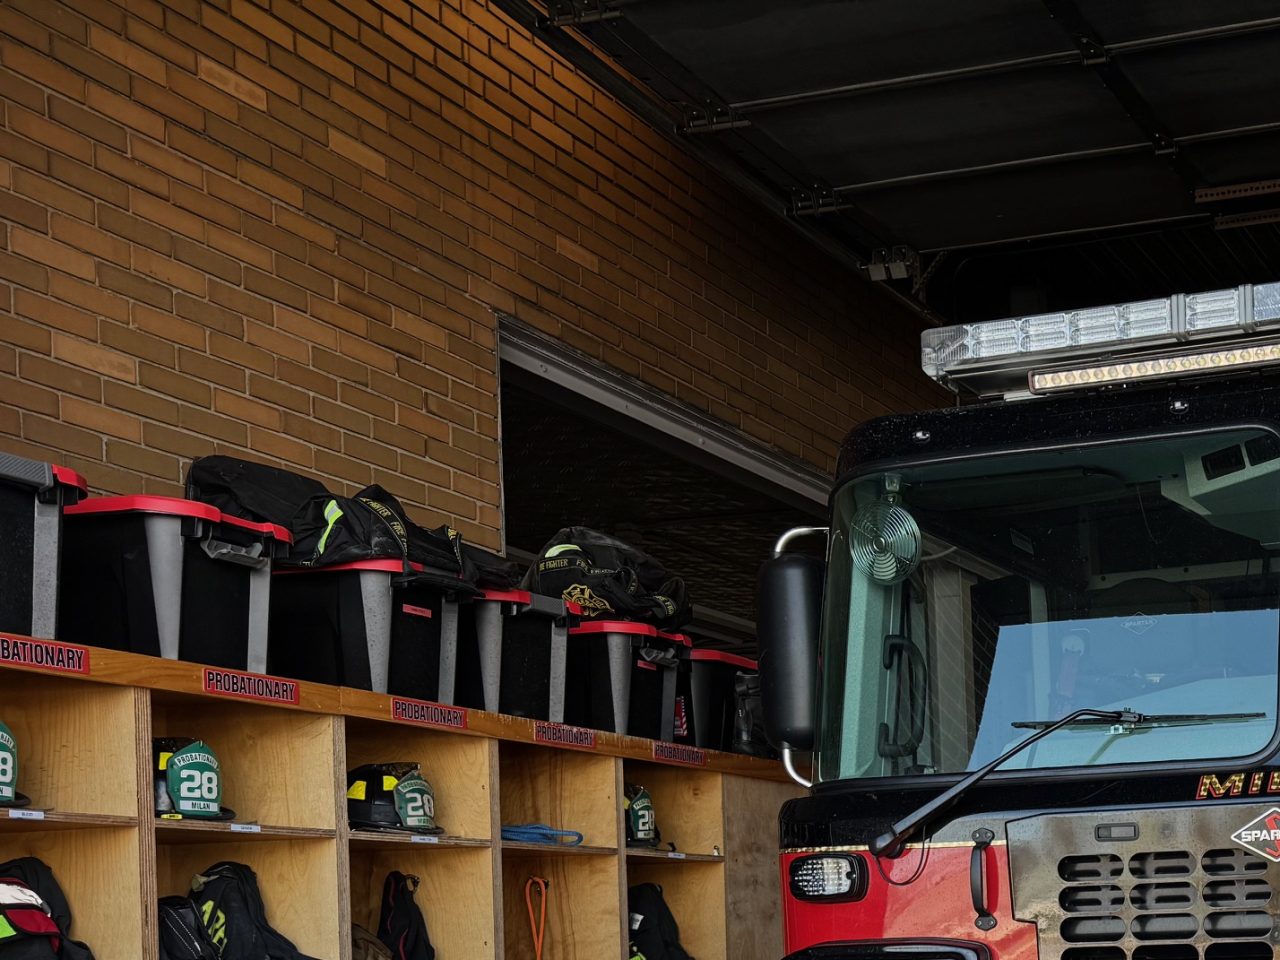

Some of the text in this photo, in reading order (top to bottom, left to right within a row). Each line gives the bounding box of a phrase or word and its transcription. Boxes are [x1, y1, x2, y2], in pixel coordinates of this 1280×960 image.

[0, 638, 84, 670] BATIONARY
[207, 671, 295, 700] PROBATIONARY
[395, 701, 464, 727] PROBATIONARY
[537, 726, 593, 746] PROBATIONARY
[176, 753, 217, 769] PROBATIONARY
[655, 745, 704, 764] PROBATIONARY
[180, 769, 218, 799] 28
[191, 802, 211, 810] MILAN
[405, 793, 434, 817] 28
[638, 810, 655, 830] 28
